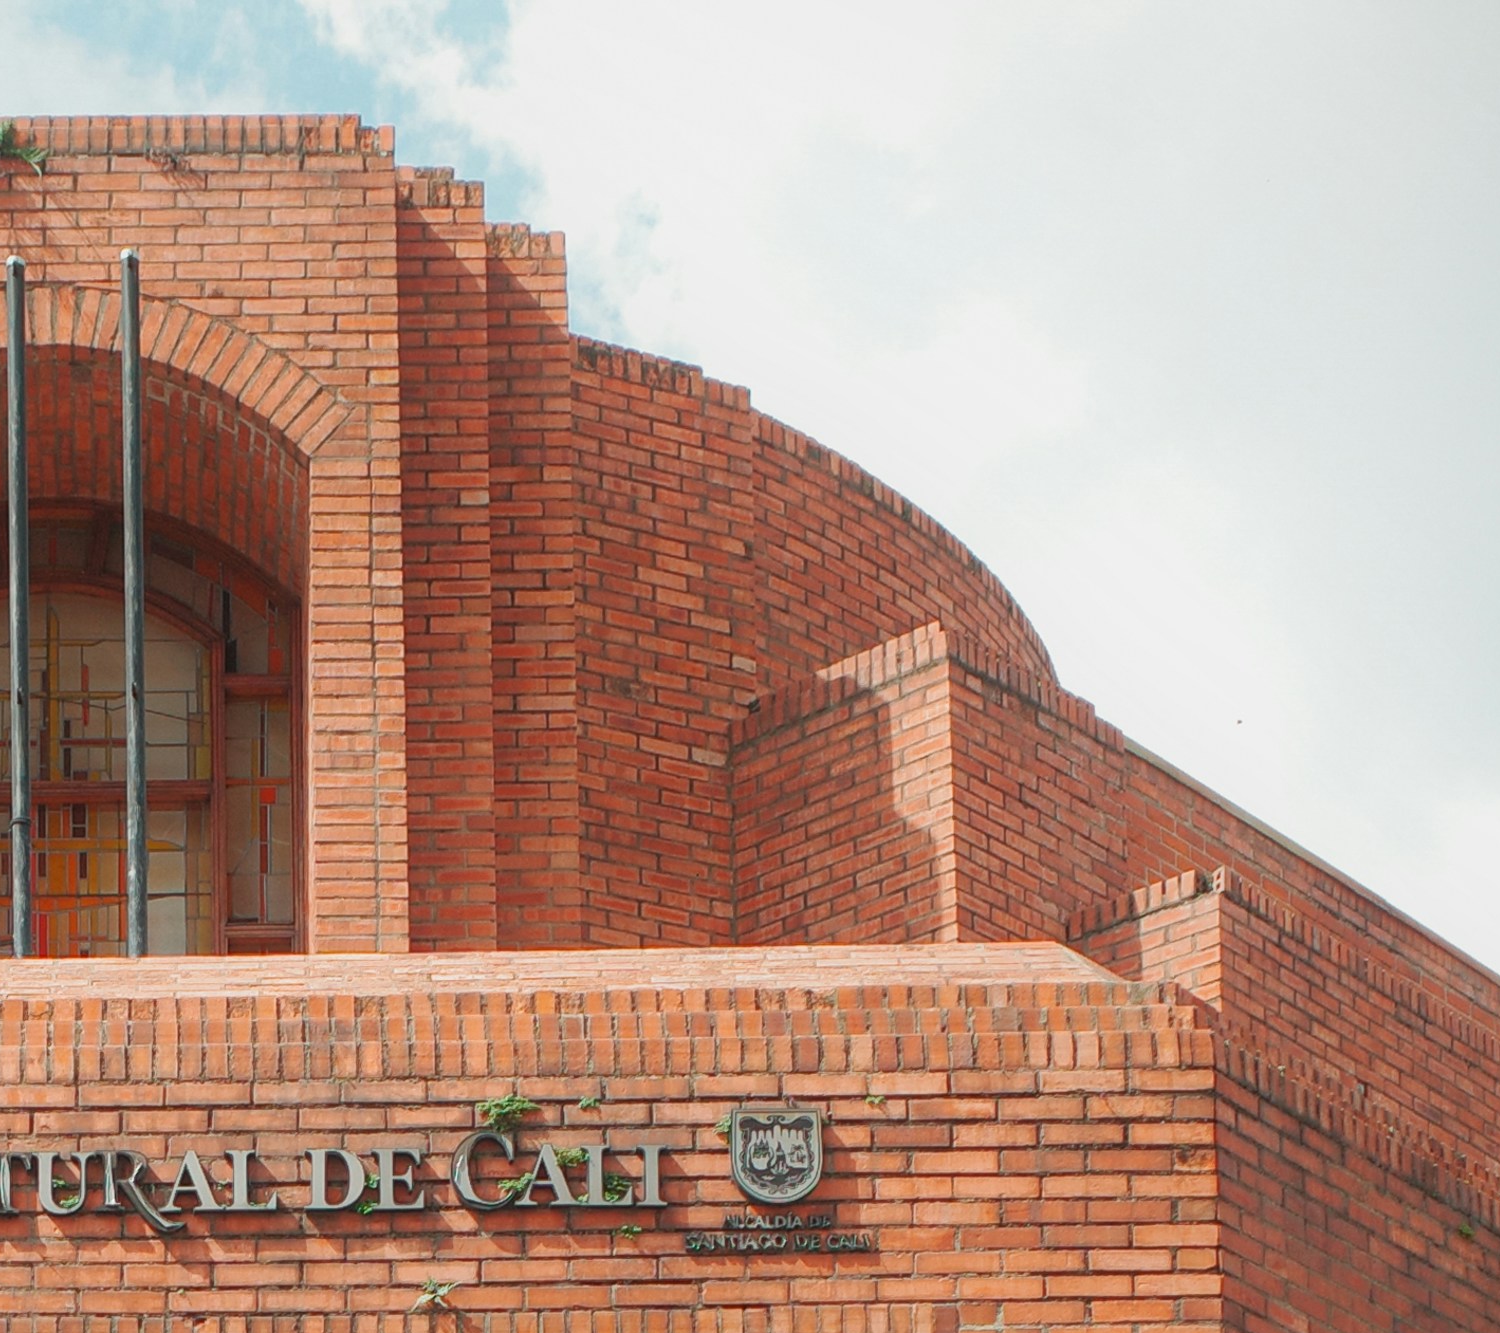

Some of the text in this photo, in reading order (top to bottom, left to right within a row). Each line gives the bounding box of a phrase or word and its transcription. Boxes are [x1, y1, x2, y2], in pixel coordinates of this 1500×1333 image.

[303, 1145, 426, 1213] DE
[450, 1131, 669, 1212] CALI
[808, 1215, 831, 1230] DE
[685, 1233, 871, 1252] SANTIAGO DE CALI
